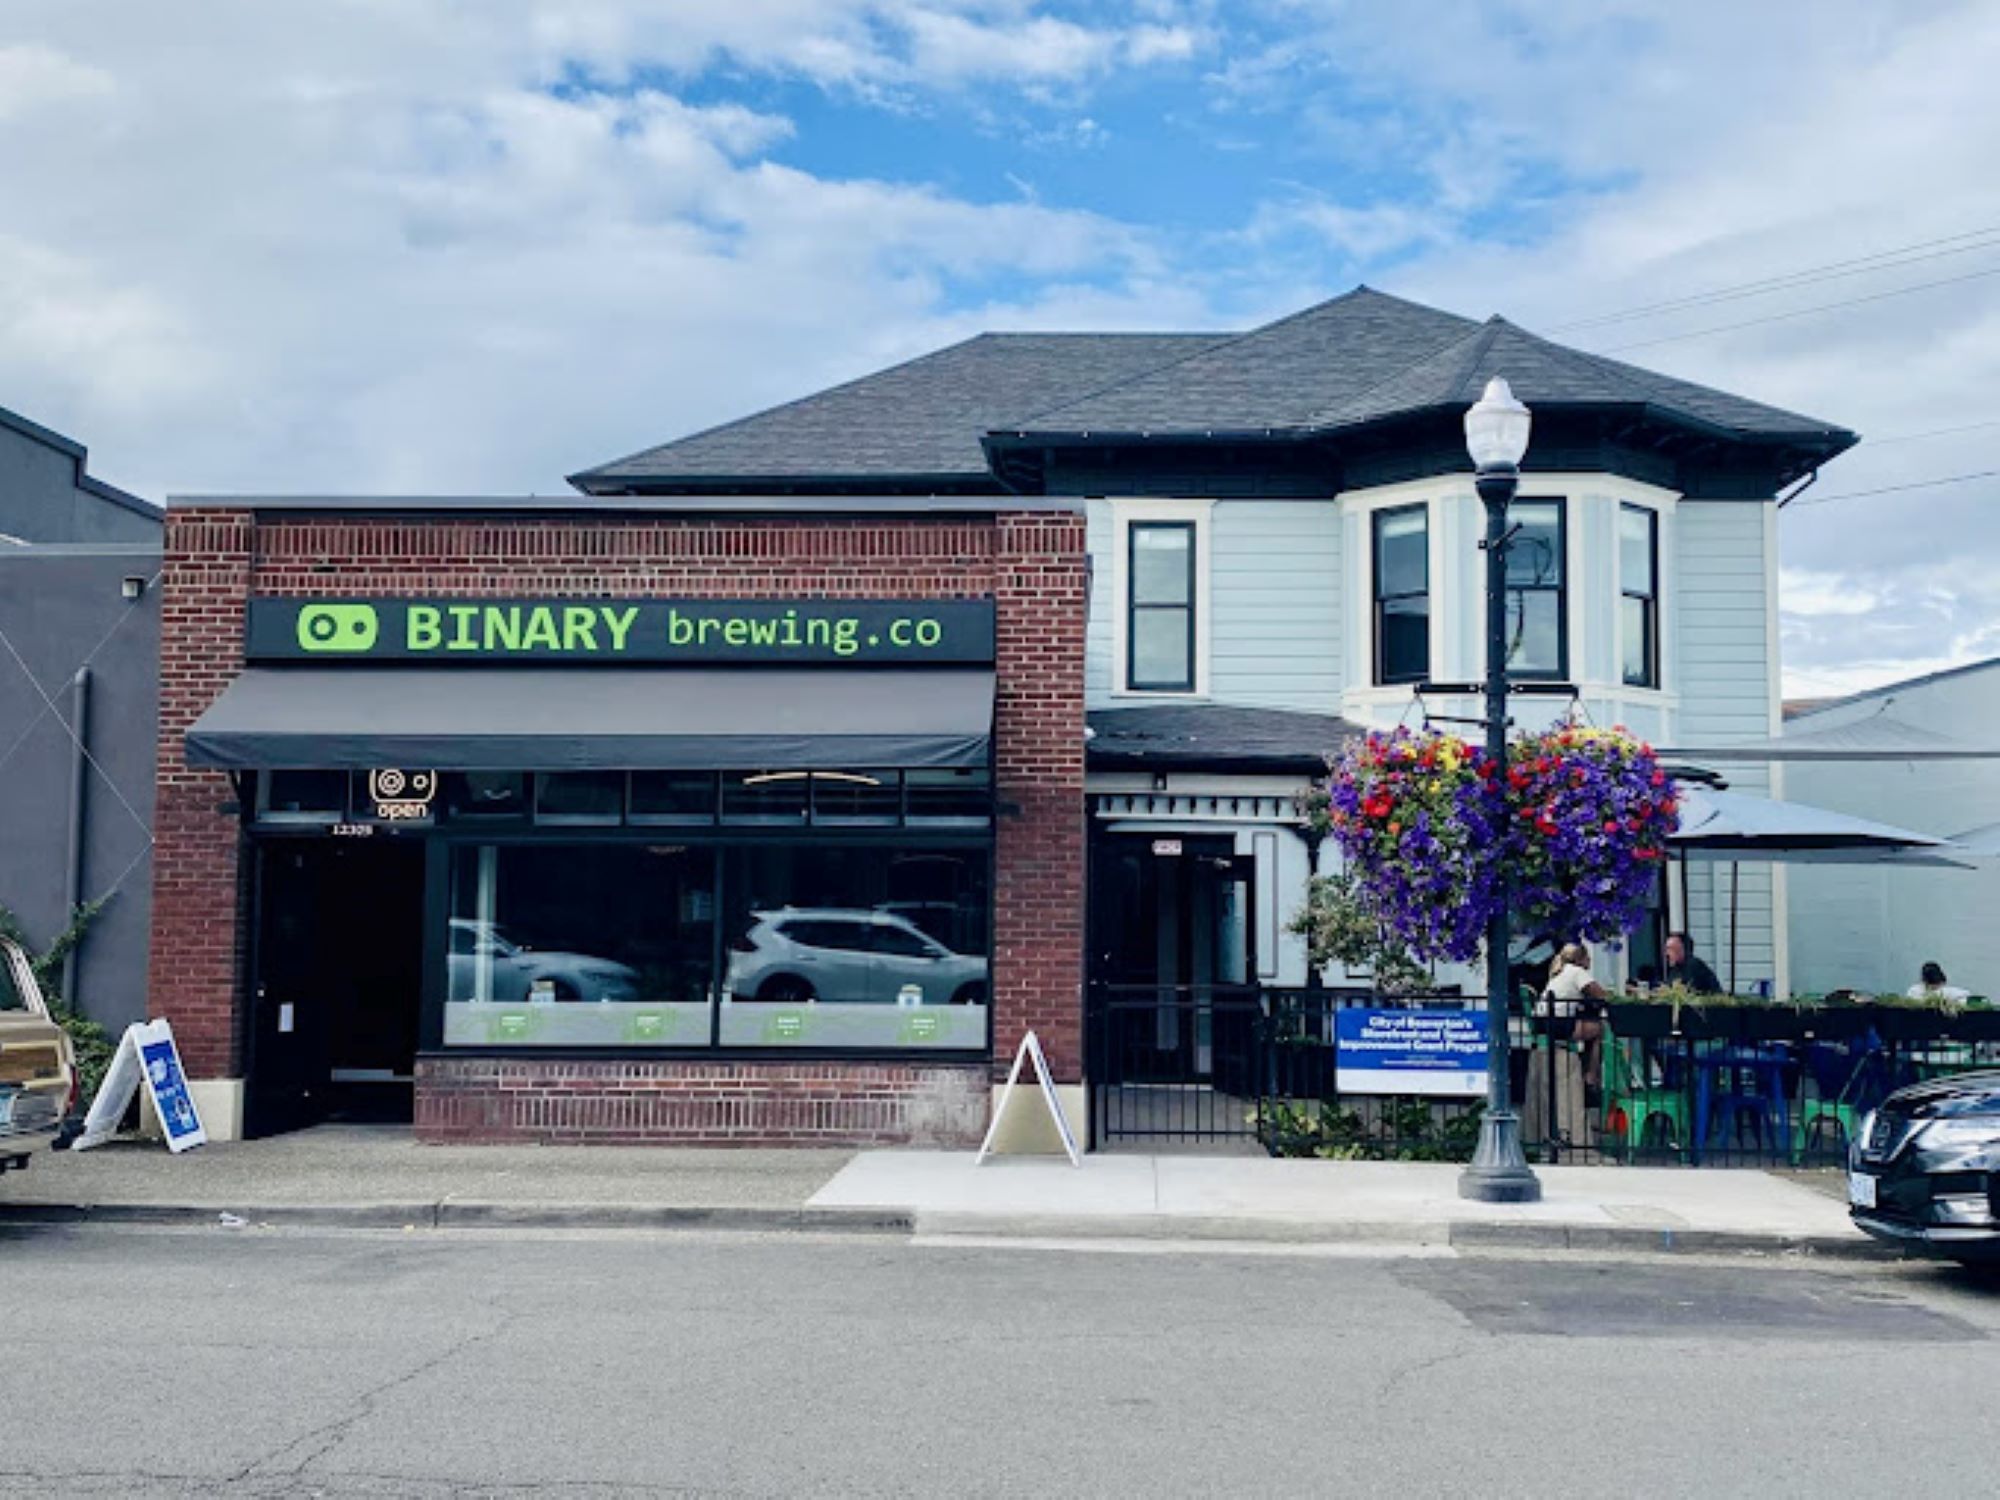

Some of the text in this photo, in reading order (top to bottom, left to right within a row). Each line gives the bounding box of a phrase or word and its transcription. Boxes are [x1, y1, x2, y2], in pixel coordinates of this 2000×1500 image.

[407, 607, 942, 655] BINARY brewing.co
[378, 803, 427, 821] open
[1445, 1041, 1488, 1053] Progra
